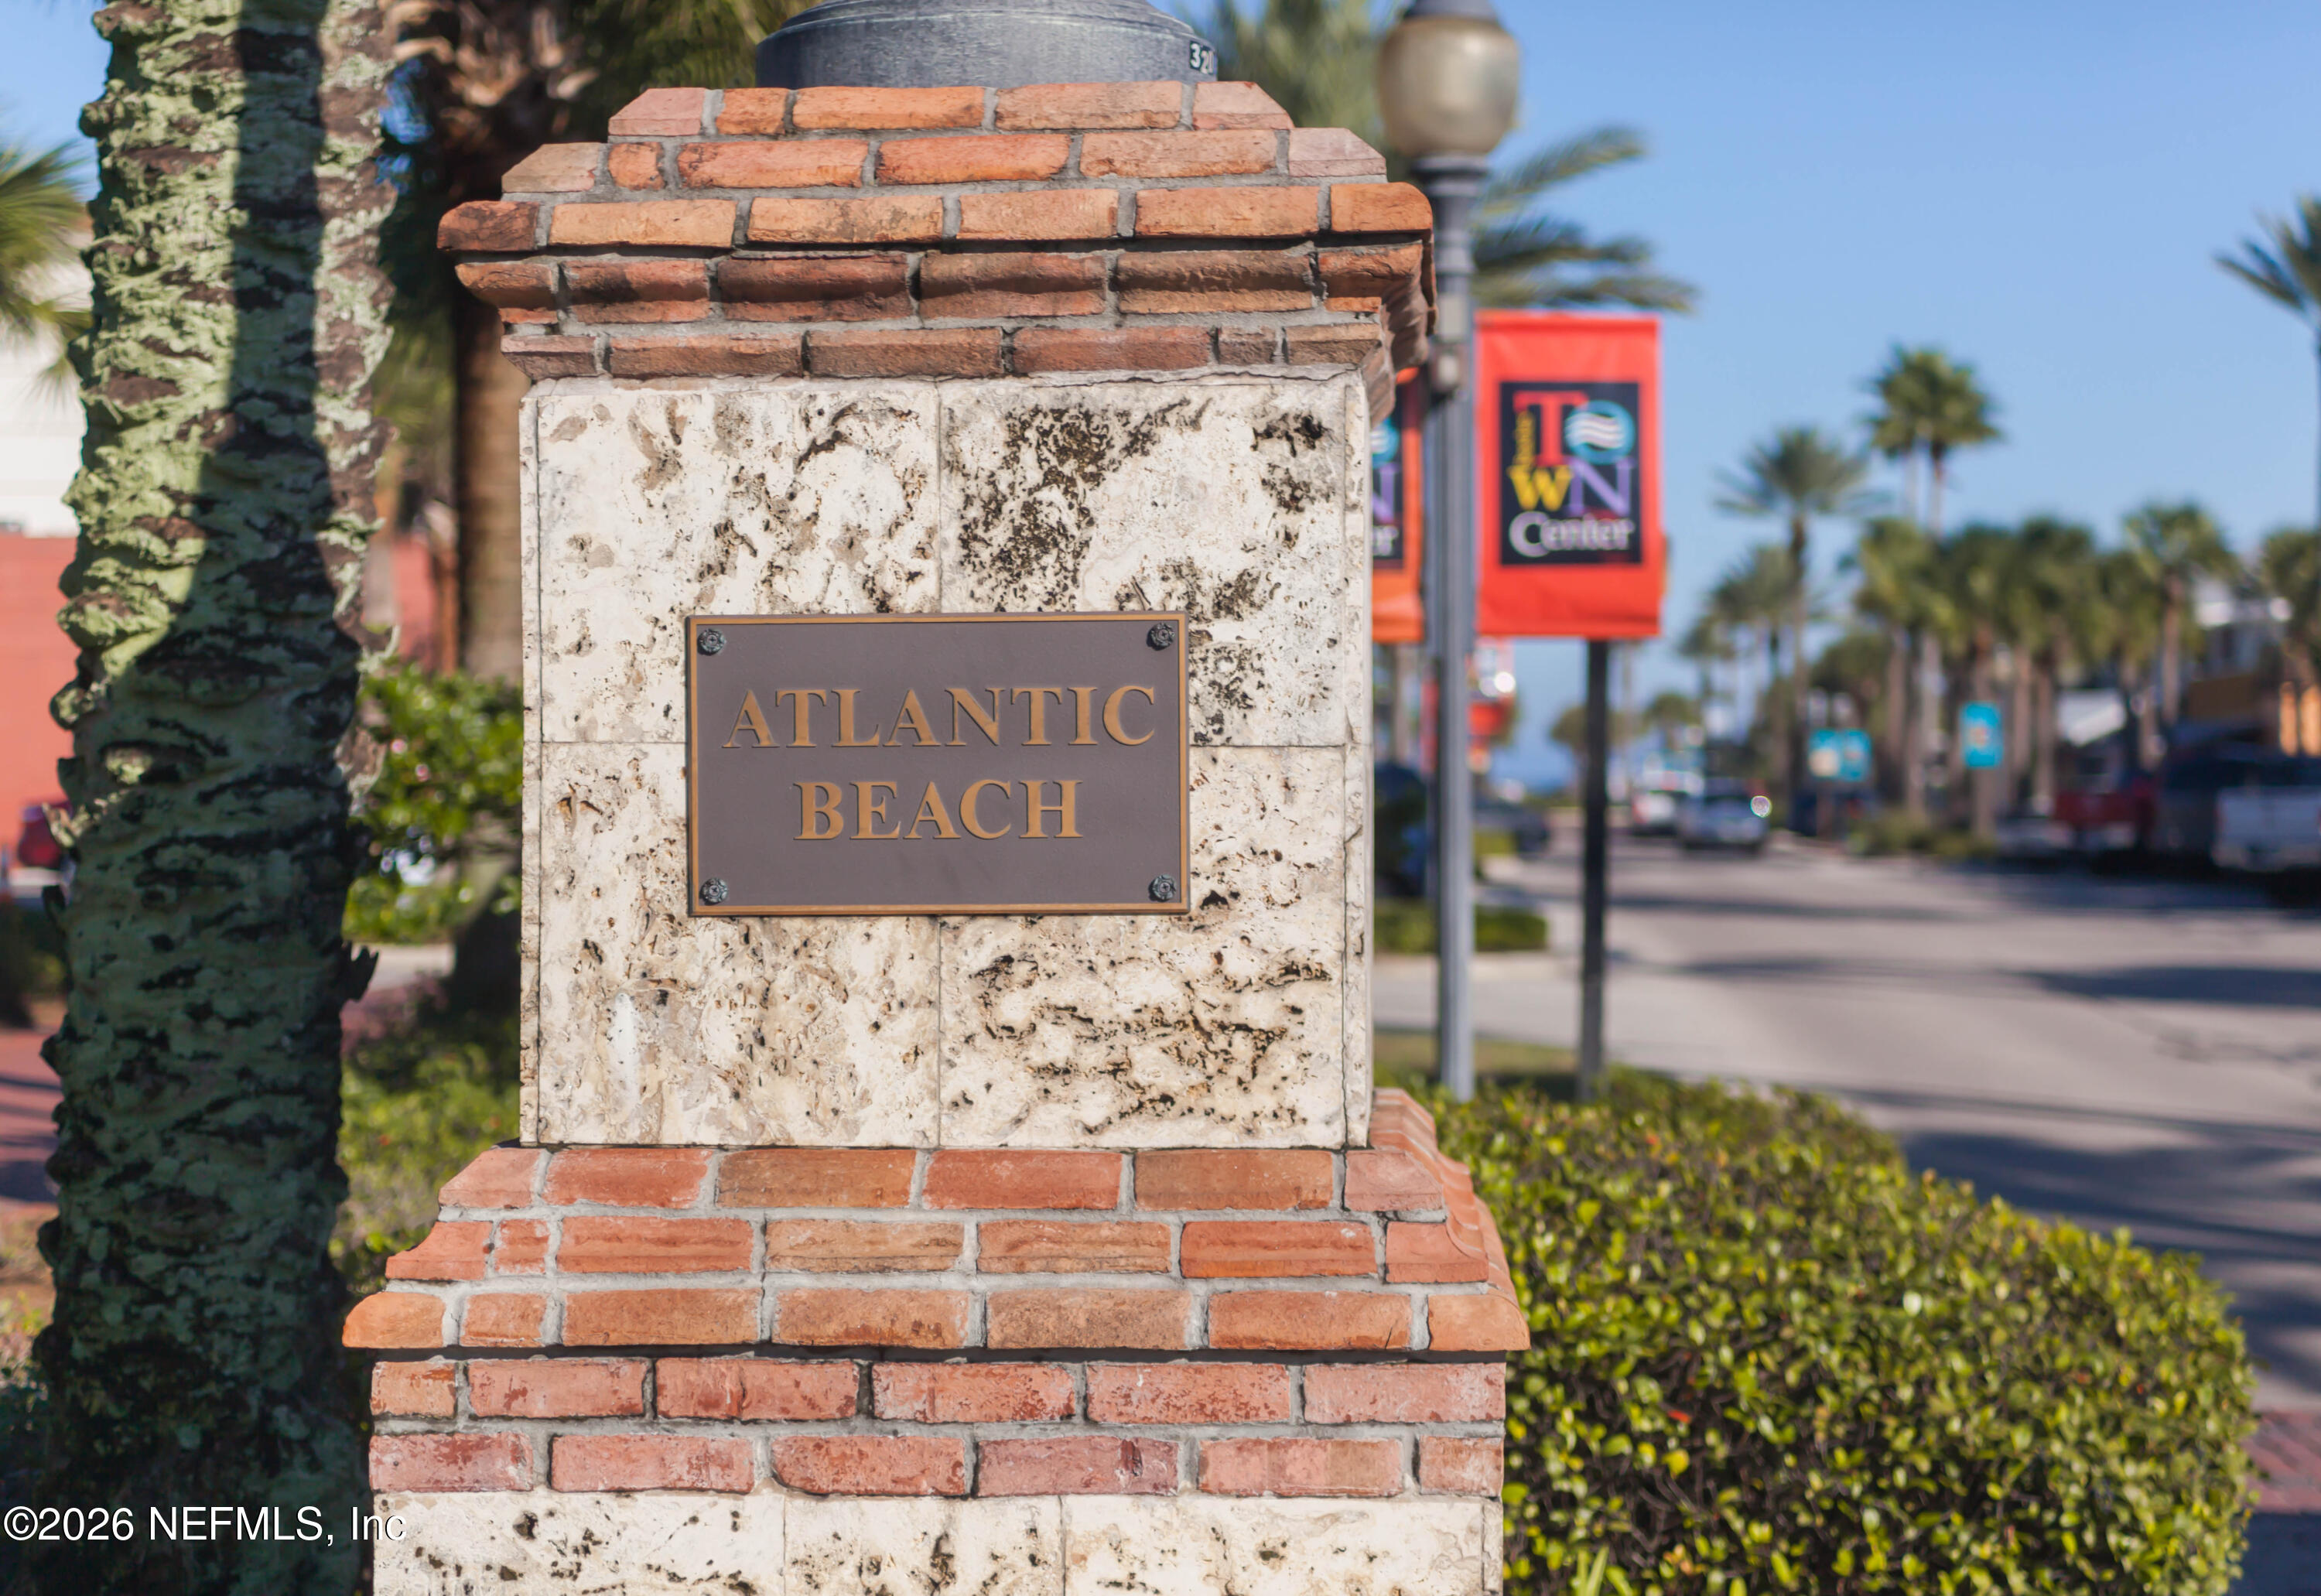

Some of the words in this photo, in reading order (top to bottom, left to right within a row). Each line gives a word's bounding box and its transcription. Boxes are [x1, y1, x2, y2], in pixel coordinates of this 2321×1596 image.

[1509, 511, 1635, 557] Center
[722, 685, 1155, 748] ATLANTIC
[793, 779, 1083, 841] BEACH
